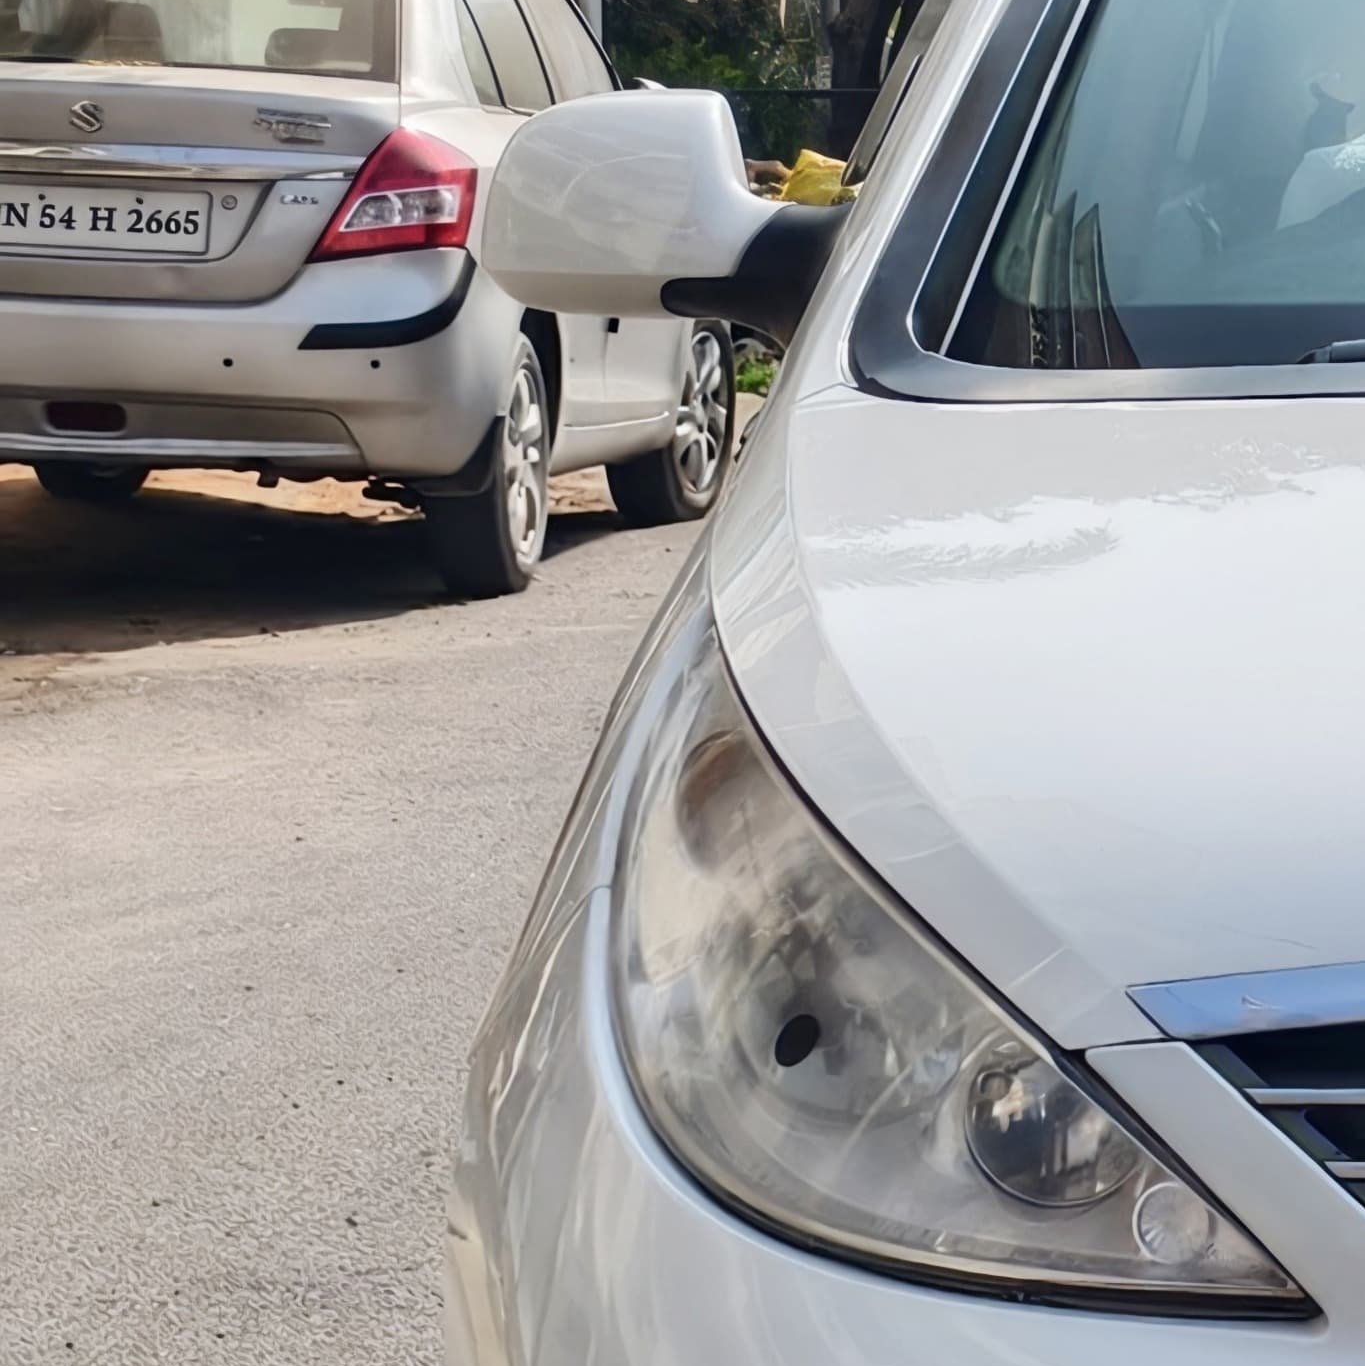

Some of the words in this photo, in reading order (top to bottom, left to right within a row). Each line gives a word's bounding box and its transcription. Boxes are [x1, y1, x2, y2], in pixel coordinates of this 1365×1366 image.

[0, 202, 30, 228] N
[40, 204, 76, 229] 54
[89, 207, 116, 231] H
[127, 209, 199, 234] 2665
